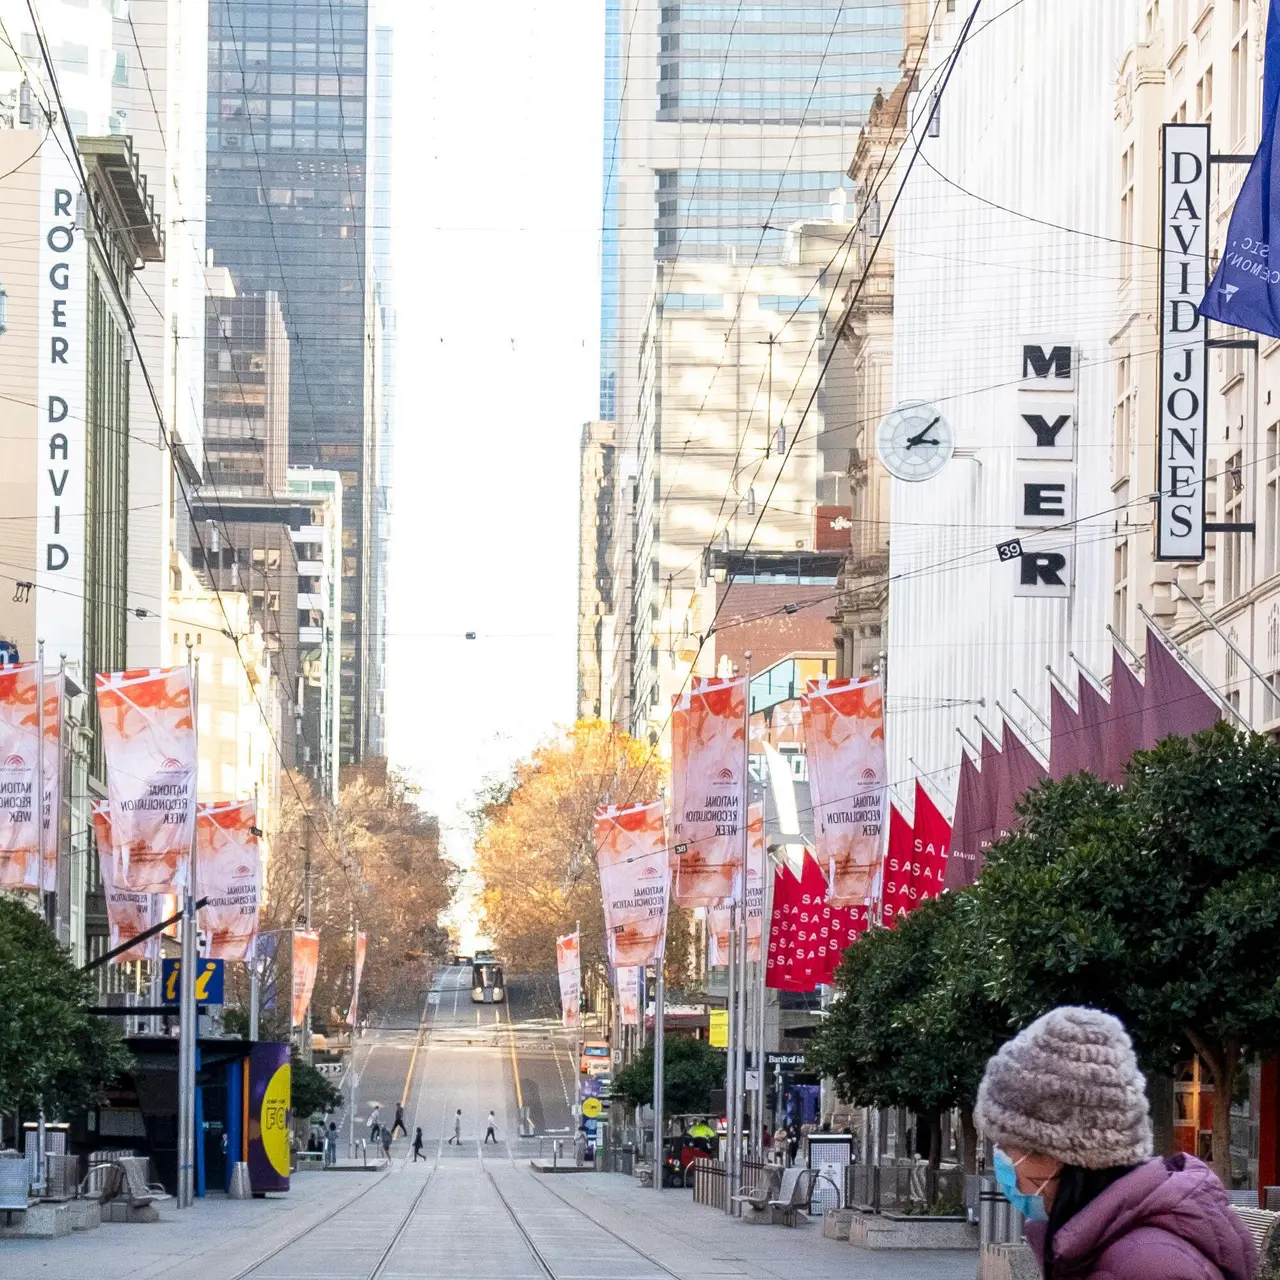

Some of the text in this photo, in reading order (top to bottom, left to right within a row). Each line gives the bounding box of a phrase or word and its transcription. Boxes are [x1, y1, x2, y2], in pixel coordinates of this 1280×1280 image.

[46, 189, 75, 571] ROGER DAVID
[1020, 344, 1072, 587] MYER
[1167, 151, 1203, 538] DAVID JONES
[1000, 543, 1019, 559] 39
[769, 1055, 787, 1063] Bank
